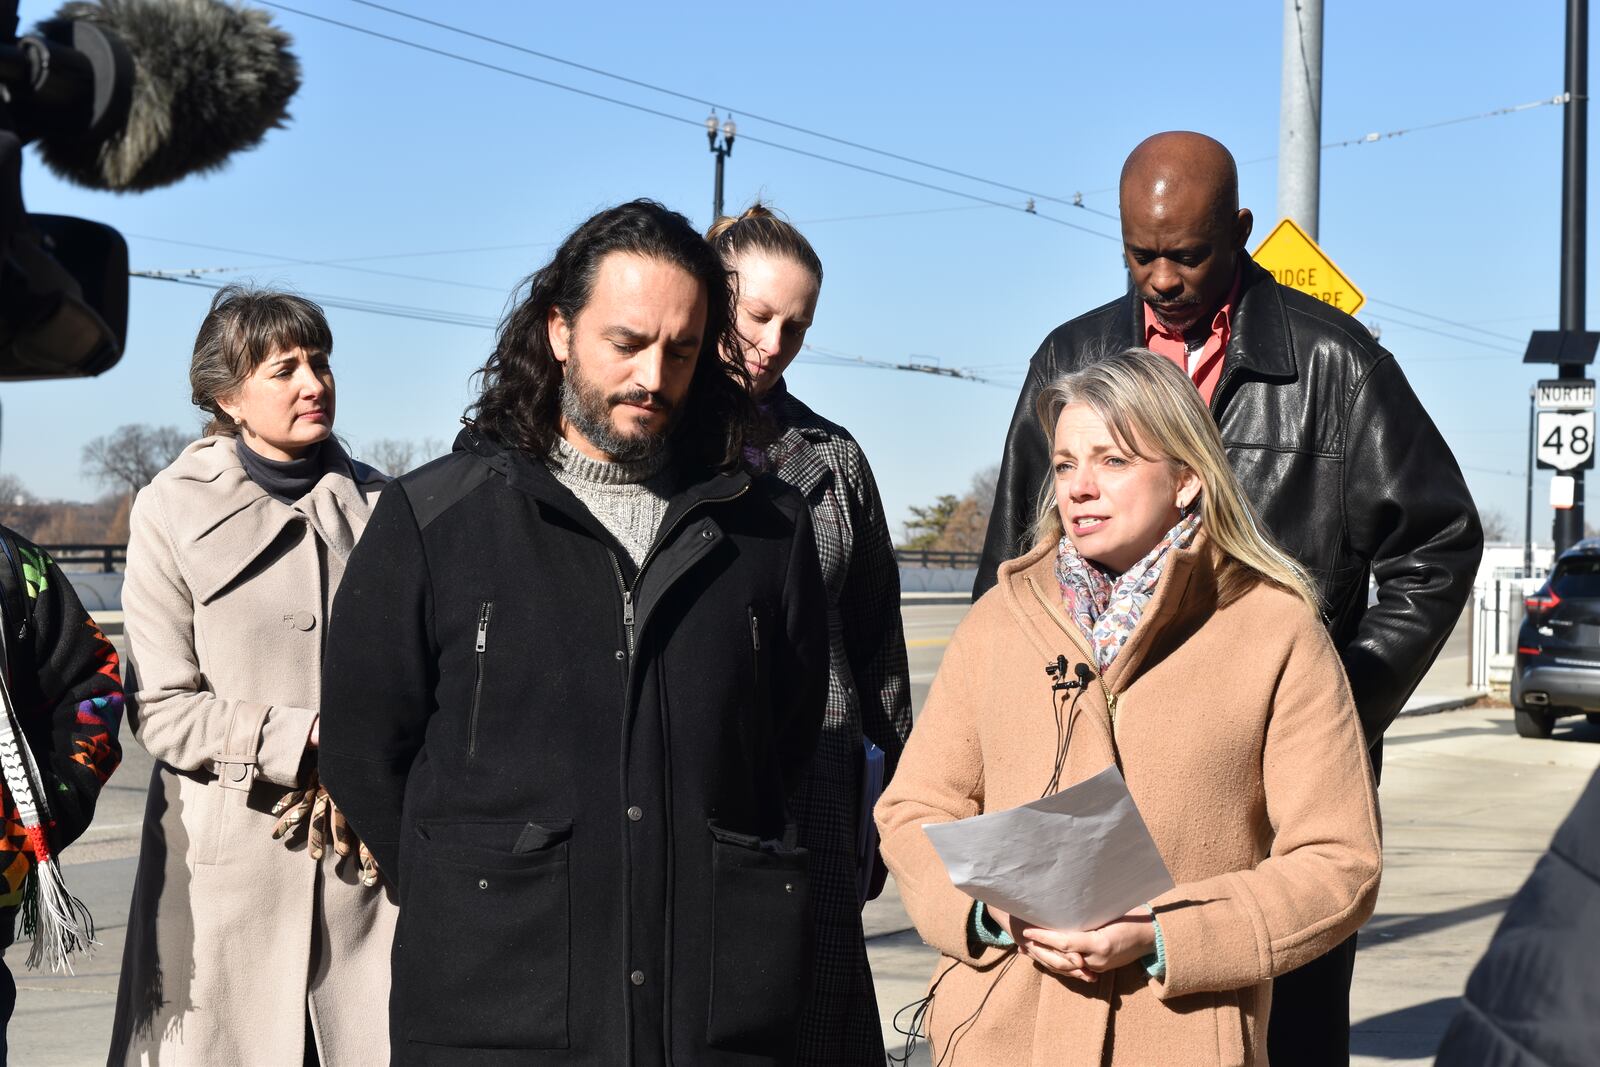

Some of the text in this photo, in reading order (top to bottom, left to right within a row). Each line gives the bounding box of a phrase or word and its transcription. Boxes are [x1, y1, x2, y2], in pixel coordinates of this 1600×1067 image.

[1311, 291, 1343, 309] RE
[1541, 385, 1592, 401] NORTH
[1542, 425, 1589, 455] 48
